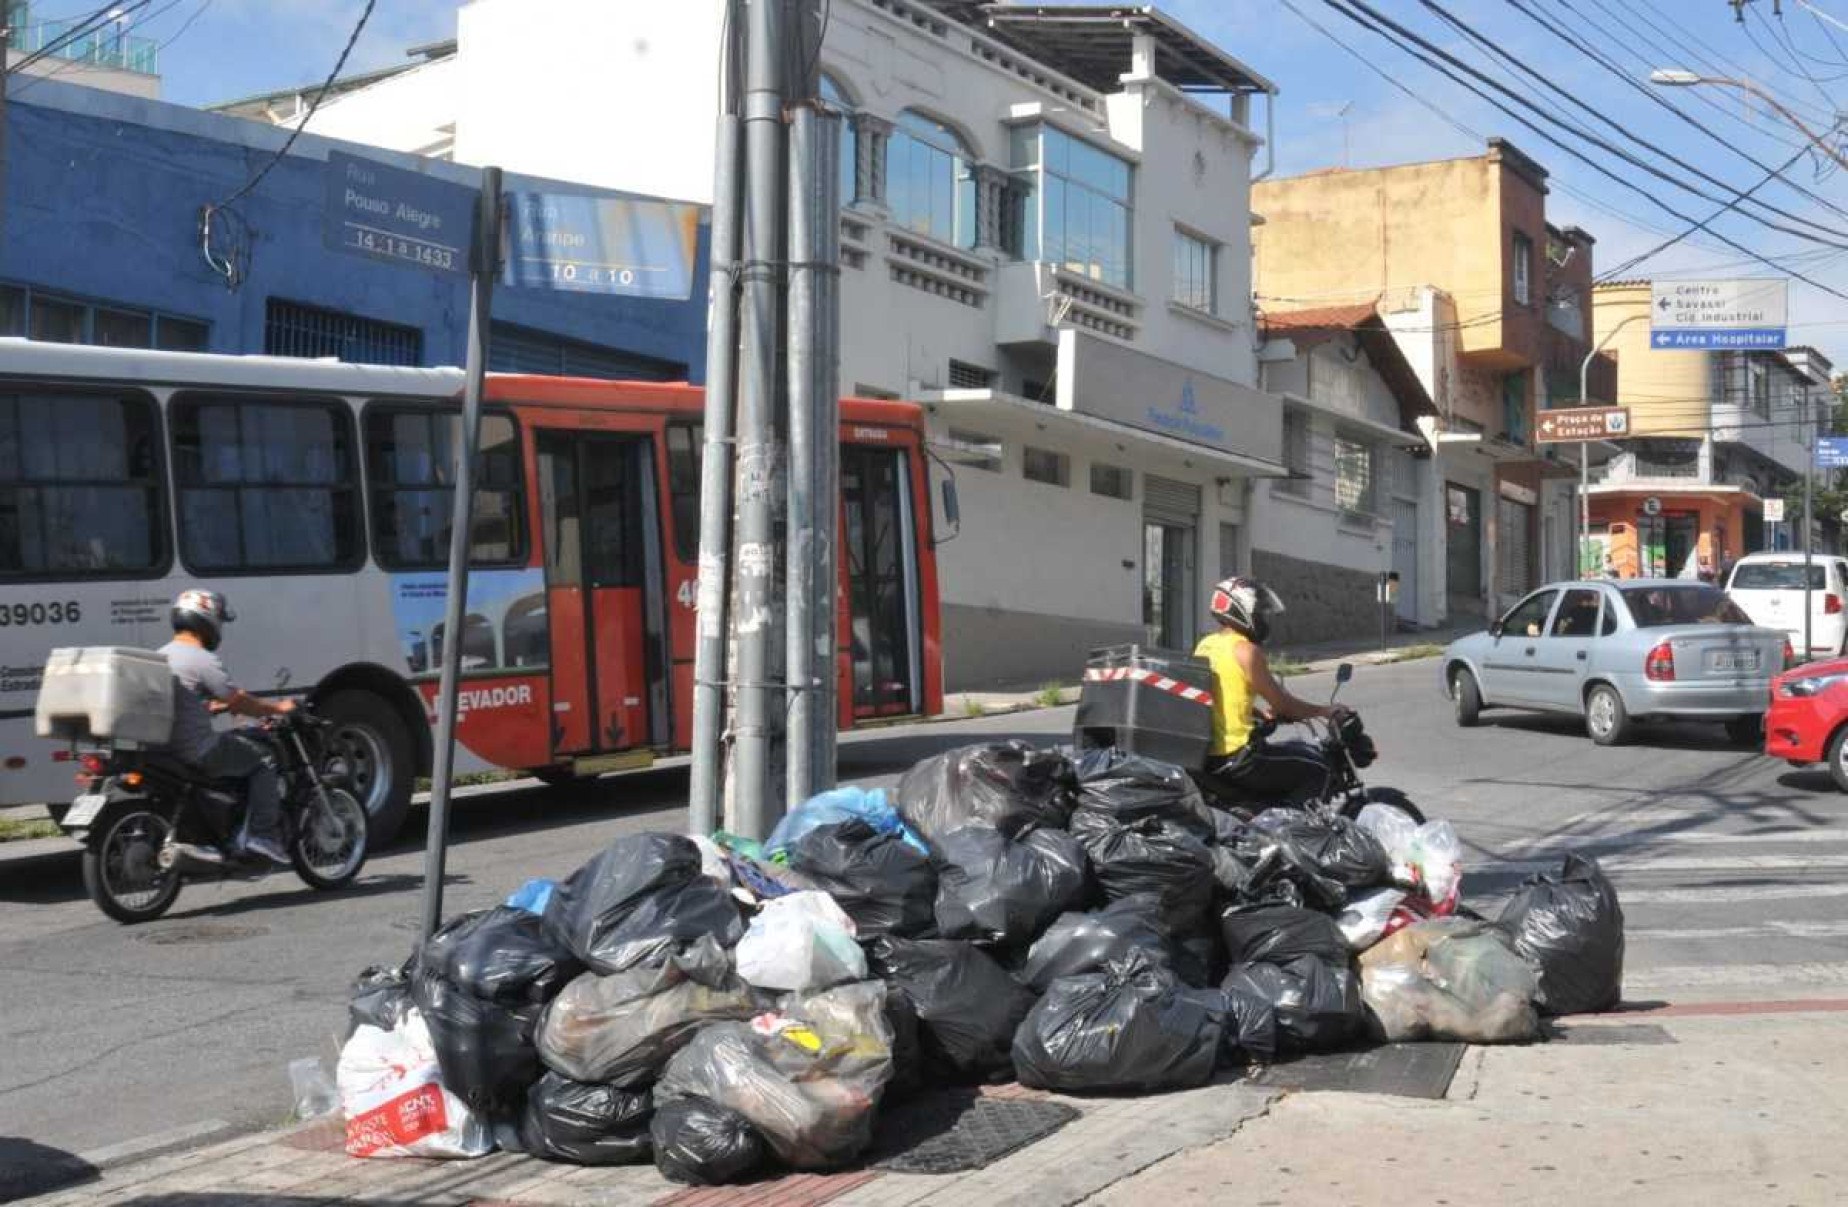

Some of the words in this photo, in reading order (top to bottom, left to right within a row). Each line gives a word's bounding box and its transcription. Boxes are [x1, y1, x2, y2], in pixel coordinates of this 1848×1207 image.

[344, 187, 390, 216] Pouso
[395, 202, 442, 230] Alegre
[1675, 284, 1720, 296] Centro
[1712, 333, 1780, 346] Hospitalar
[0, 600, 81, 627] 39036
